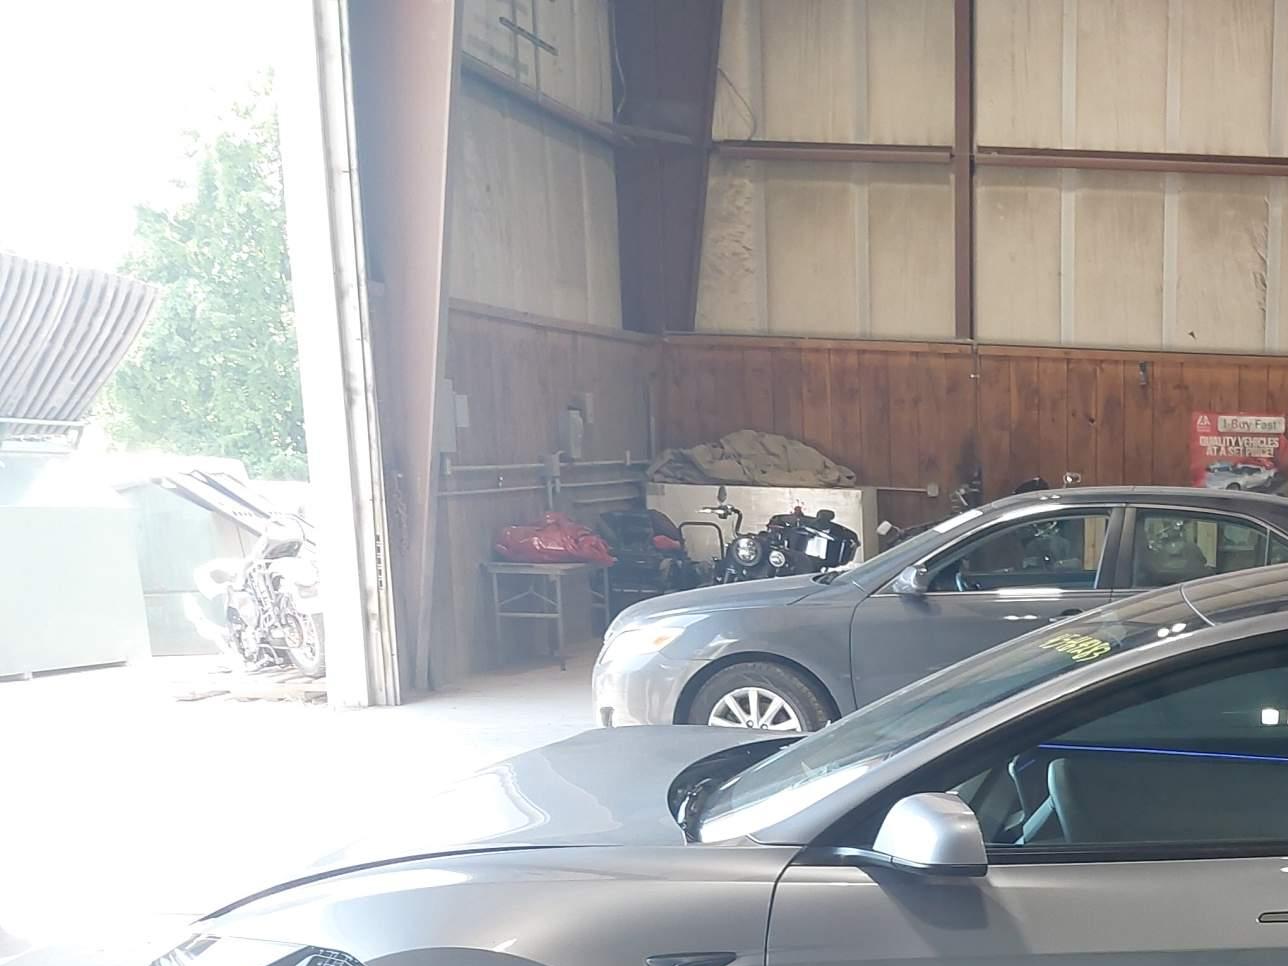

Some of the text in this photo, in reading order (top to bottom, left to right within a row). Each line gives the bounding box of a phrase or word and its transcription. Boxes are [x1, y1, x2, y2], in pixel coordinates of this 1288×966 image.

[1255, 419, 1277, 430] Fast
[1200, 436, 1280, 449] QUALITY VEHICLES
